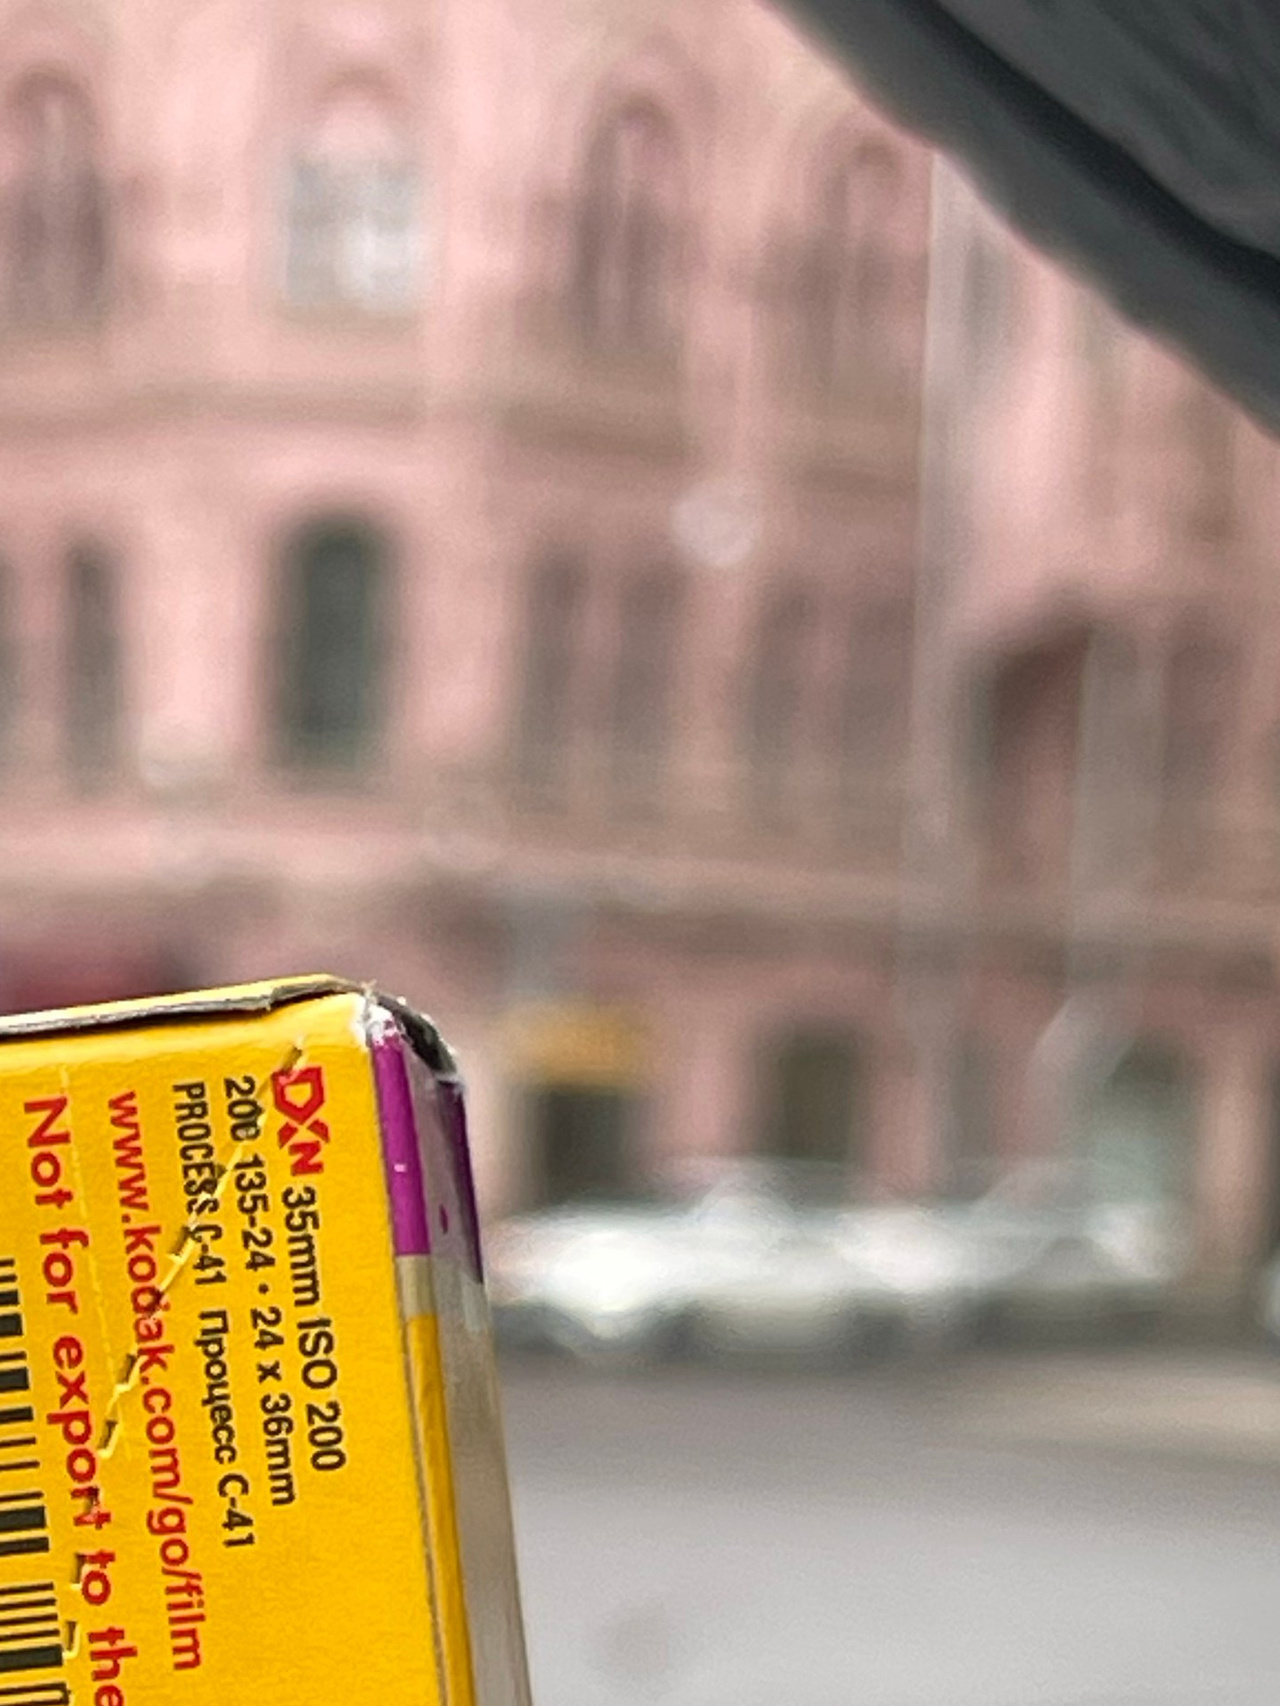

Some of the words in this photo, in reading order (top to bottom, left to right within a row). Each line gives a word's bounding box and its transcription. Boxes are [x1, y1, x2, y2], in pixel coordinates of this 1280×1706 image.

[24, 1097, 74, 1210] Not
[173, 1081, 220, 1217] PROCESS
[224, 1075, 262, 1142] 200
[193, 1227, 227, 1285] C-41
[234, 1155, 276, 1273] 135-24
[281, 1185, 321, 1308] 35mm
[40, 1228, 89, 1315] for
[107, 1090, 206, 1671] www.kodak.com/go/film
[250, 1308, 285, 1350] 24
[296, 1317, 338, 1391] ISO
[47, 1335, 111, 1529] export
[194, 1310, 238, 1465] Процесс
[218, 1473, 256, 1549] C-41
[259, 1393, 297, 1506] 36mm
[305, 1401, 347, 1473] 200
[81, 1548, 115, 1606] to
